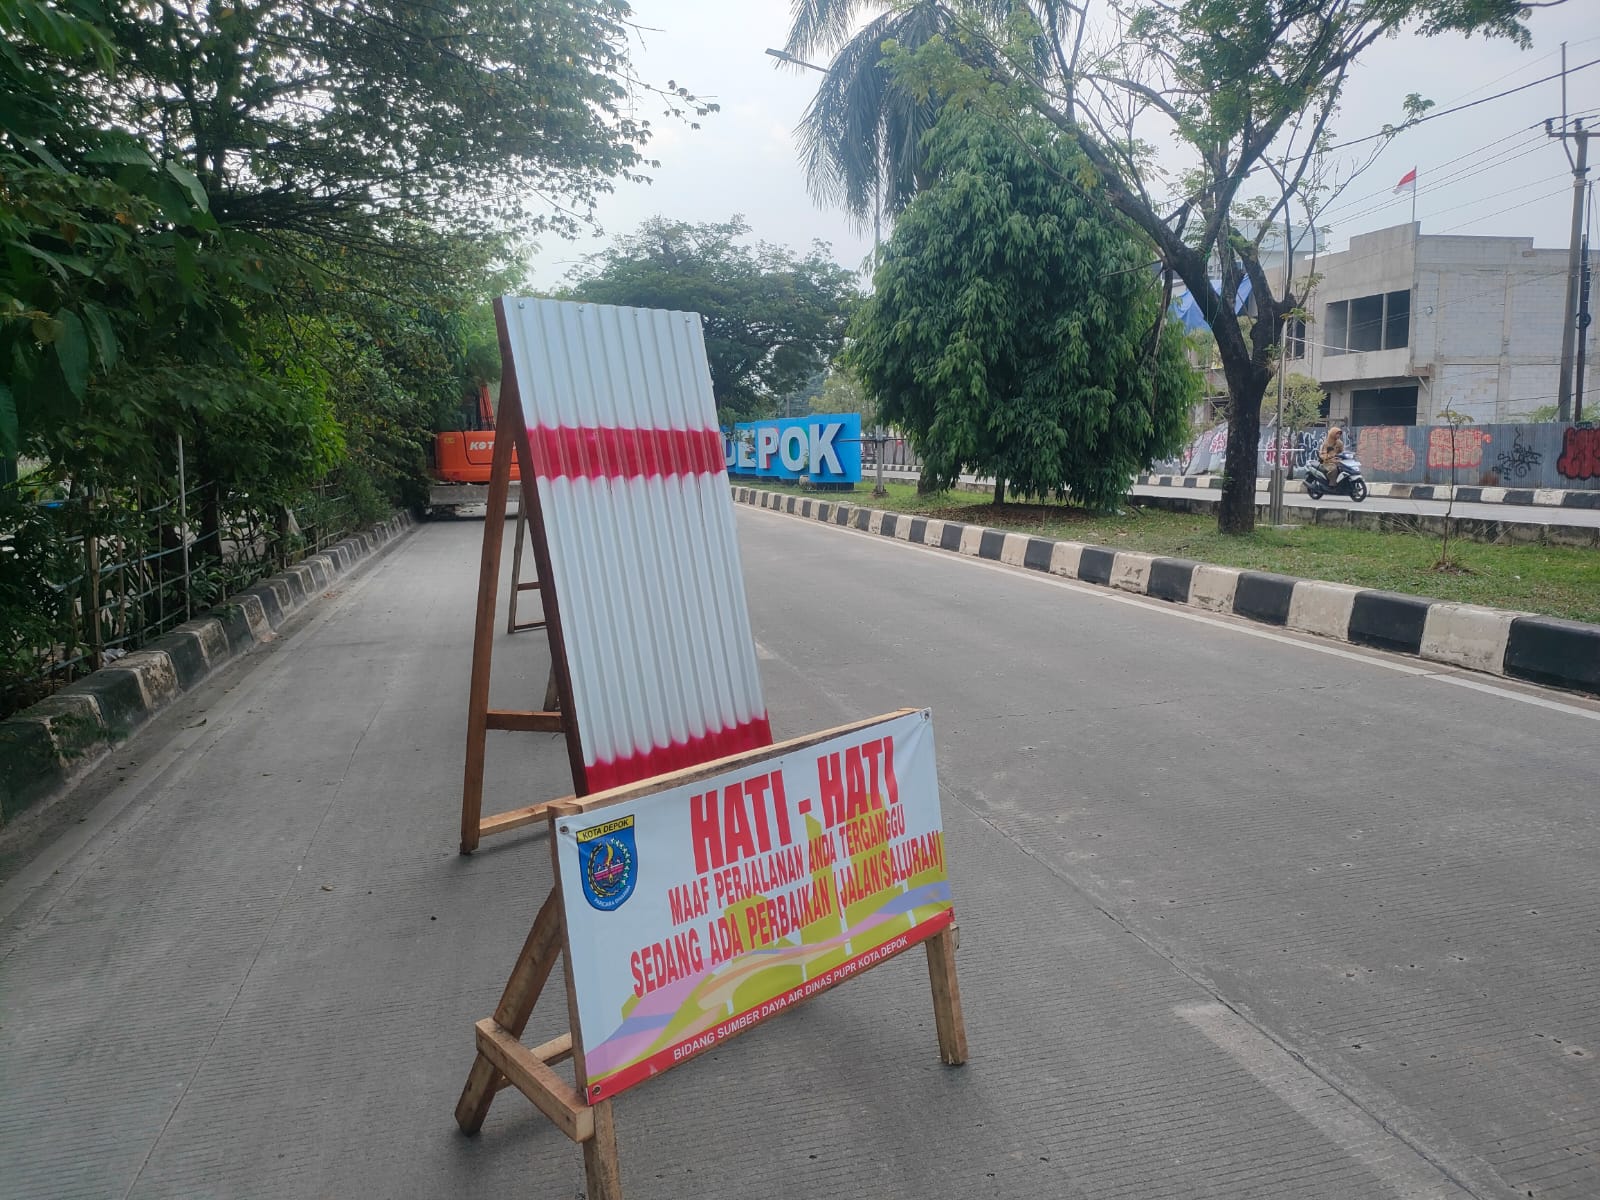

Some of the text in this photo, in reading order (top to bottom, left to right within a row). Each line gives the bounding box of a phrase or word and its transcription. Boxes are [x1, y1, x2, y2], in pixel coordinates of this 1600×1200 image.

[582, 818, 629, 840] KOTA DEPOK
[668, 804, 906, 926] MAAF PERJALANAN ANDA TERGANGGU
[690, 769, 792, 875] HATI
[817, 736, 898, 829] HATI
[630, 927, 704, 998] SEDANG
[708, 913, 744, 965] ADA
[745, 875, 831, 949] PERBAIKAN
[673, 936, 908, 1061] BIDANG SUMBER DAYA AIR DINAS PUPR KOTA DEPOK
